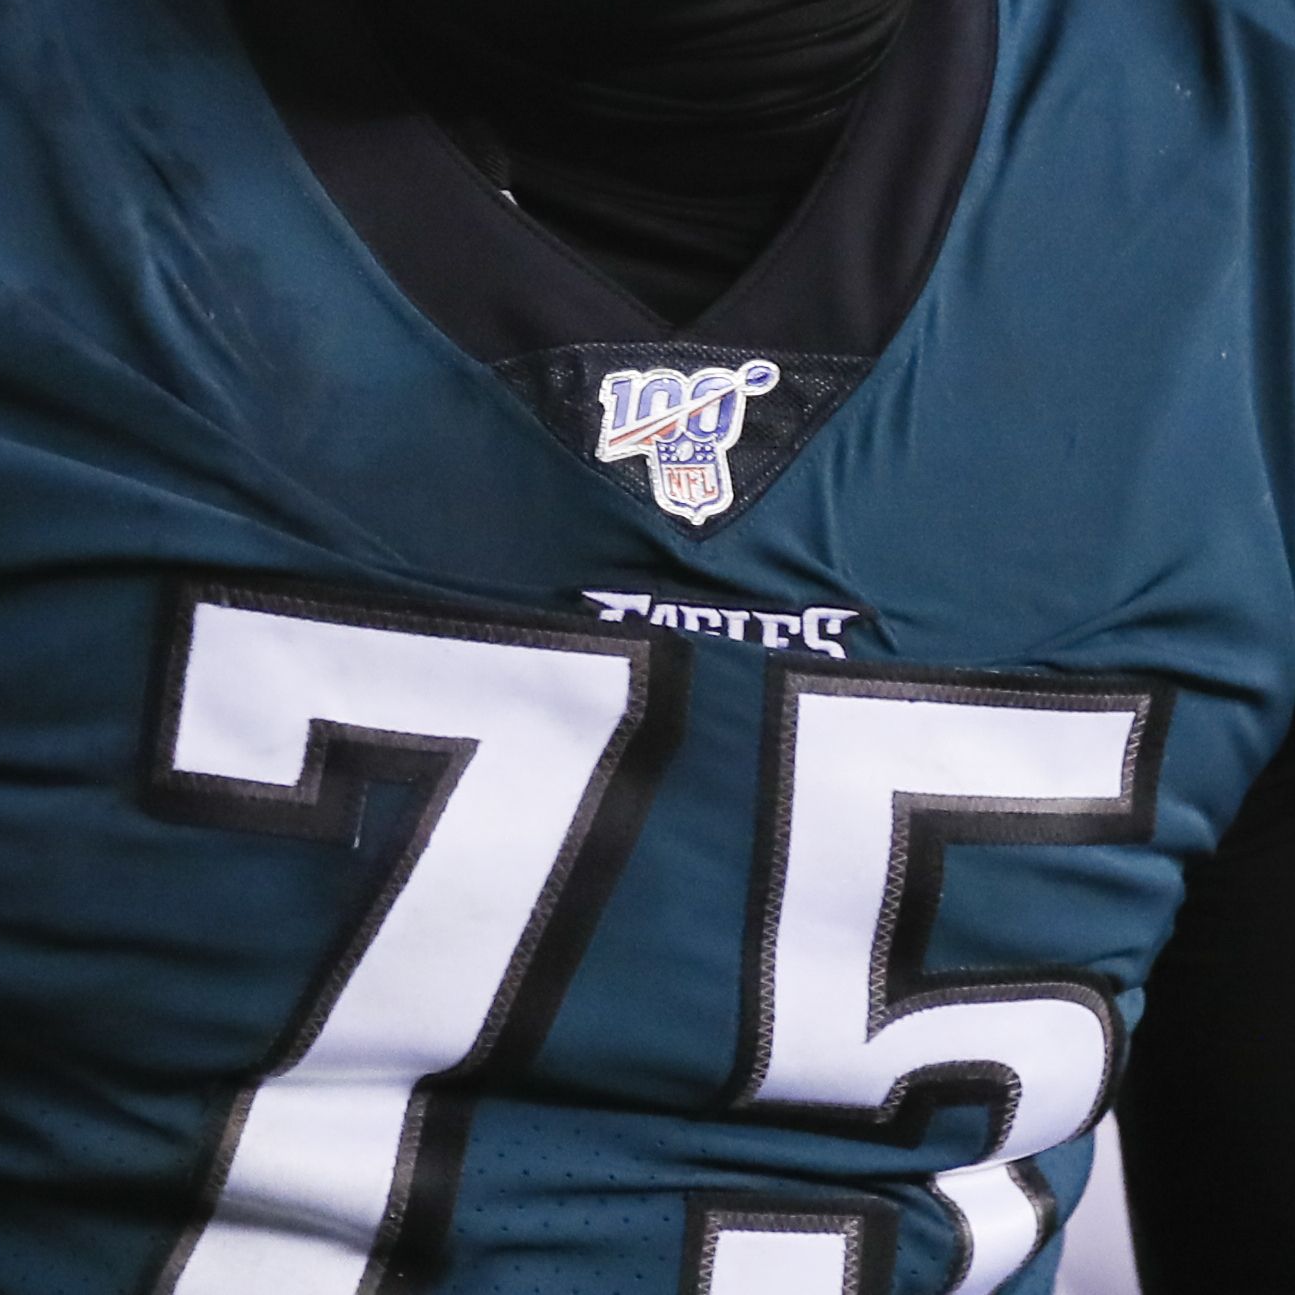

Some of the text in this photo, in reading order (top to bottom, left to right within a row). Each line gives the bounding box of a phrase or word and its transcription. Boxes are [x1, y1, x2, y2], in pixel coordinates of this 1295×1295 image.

[607, 374, 740, 444] 100
[665, 464, 719, 504] NFL
[150, 586, 1152, 1295] 75
